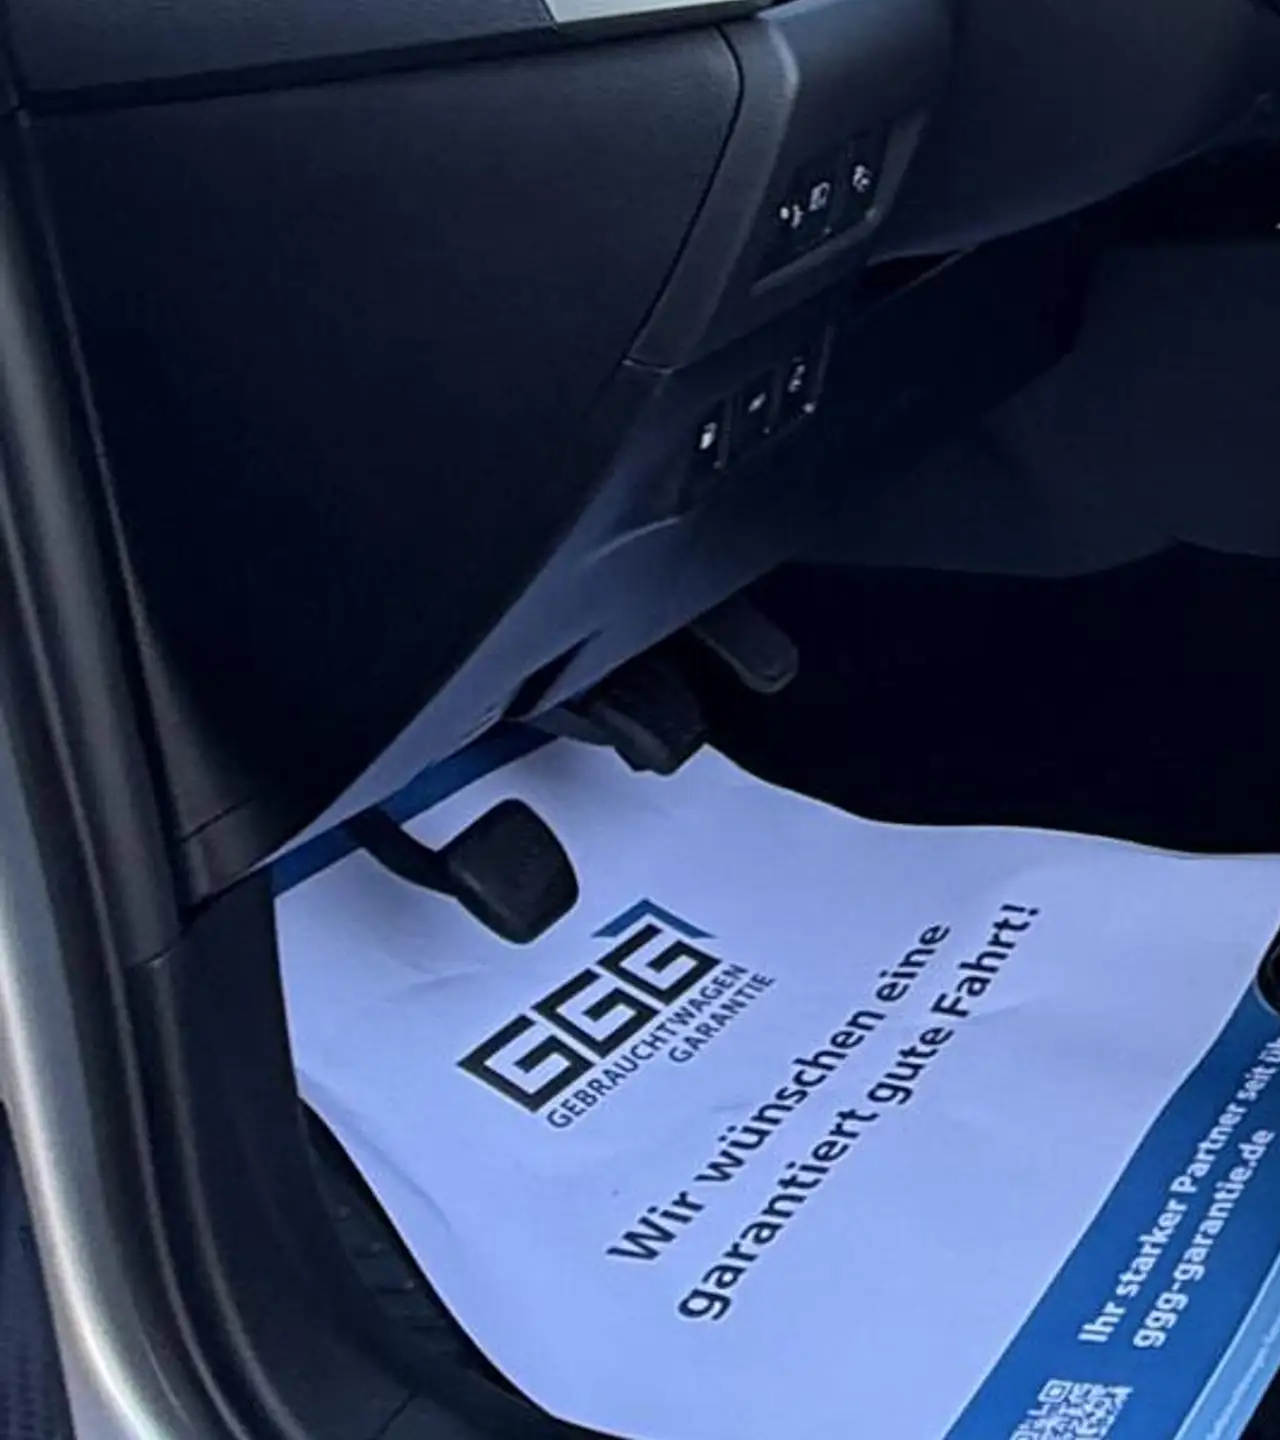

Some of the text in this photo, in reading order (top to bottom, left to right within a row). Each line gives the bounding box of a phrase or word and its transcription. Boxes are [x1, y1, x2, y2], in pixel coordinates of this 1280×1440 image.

[456, 923, 723, 1113] GGG
[547, 964, 747, 1128] GEBRAUCHTWAGEN
[607, 923, 950, 1260] Wir wünschen eine
[668, 972, 775, 1064] GARANTIE
[678, 904, 1039, 1320] garantiert gute Fahrt!
[1078, 1302, 1126, 1343] Ihr
[1117, 1199, 1187, 1297] starker
[1171, 1102, 1247, 1193] Partner
[1238, 1065, 1276, 1102] seit
[1133, 1129, 1276, 1349] ggg-garantie.de
